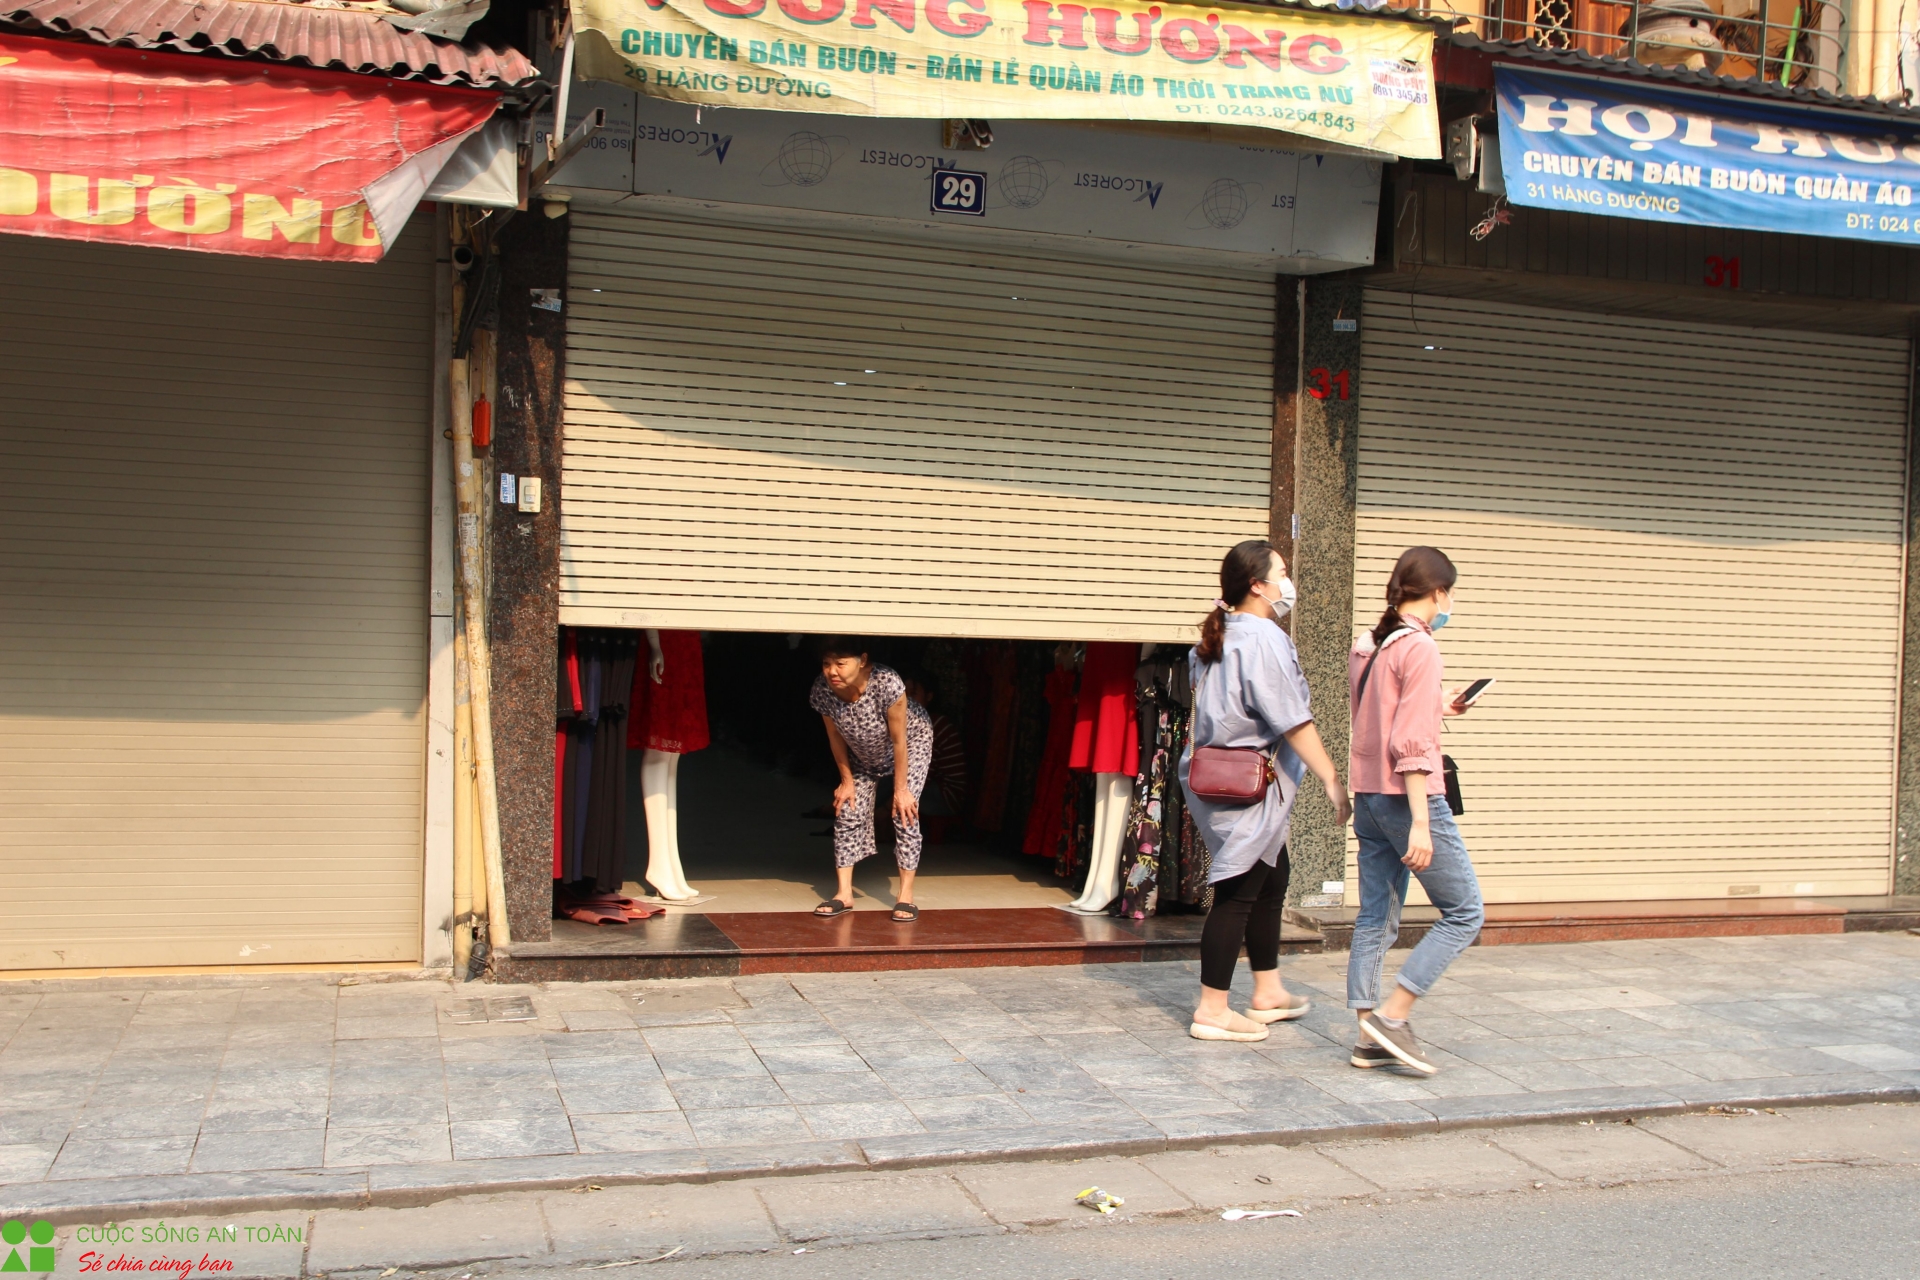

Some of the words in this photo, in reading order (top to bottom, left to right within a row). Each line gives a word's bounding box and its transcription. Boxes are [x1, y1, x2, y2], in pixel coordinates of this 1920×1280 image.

[1021, 0, 1351, 75] HƯƠNG
[621, 29, 738, 62] CHUYÊN
[749, 38, 807, 68] BÁN
[817, 45, 897, 75] BUÔN
[926, 53, 982, 83] BÁN
[992, 57, 1019, 86] LẺ
[1029, 60, 1101, 93] QUẦN
[1110, 70, 1144, 97] ÁO
[1153, 77, 1216, 99] THỜI
[1222, 84, 1312, 100] TRANG
[1318, 84, 1354, 105] NỮ
[623, 63, 648, 83] 29
[656, 66, 729, 92] HÀNG
[735, 73, 832, 99] ĐƯỜNG
[1175, 104, 1210, 115] ĐT:
[1217, 104, 1355, 133] 0243.8264.843
[636, 124, 733, 165] ALCORES
[942, 176, 976, 208] 29
[1523, 150, 1634, 183] CHUYÊN
[1643, 160, 1701, 188] BÁN
[1710, 167, 1786, 195] BUÔN
[1794, 172, 1869, 203] QUẦN
[1875, 180, 1912, 207] ÁO
[1526, 182, 1546, 199] 31
[1552, 184, 1603, 205] HÀNG
[1606, 190, 1680, 214] ĐƯỜNG
[1846, 212, 1874, 230] ĐT:
[1879, 215, 1909, 233] 024
[1704, 254, 1740, 288] 31
[1308, 366, 1350, 401] 31
